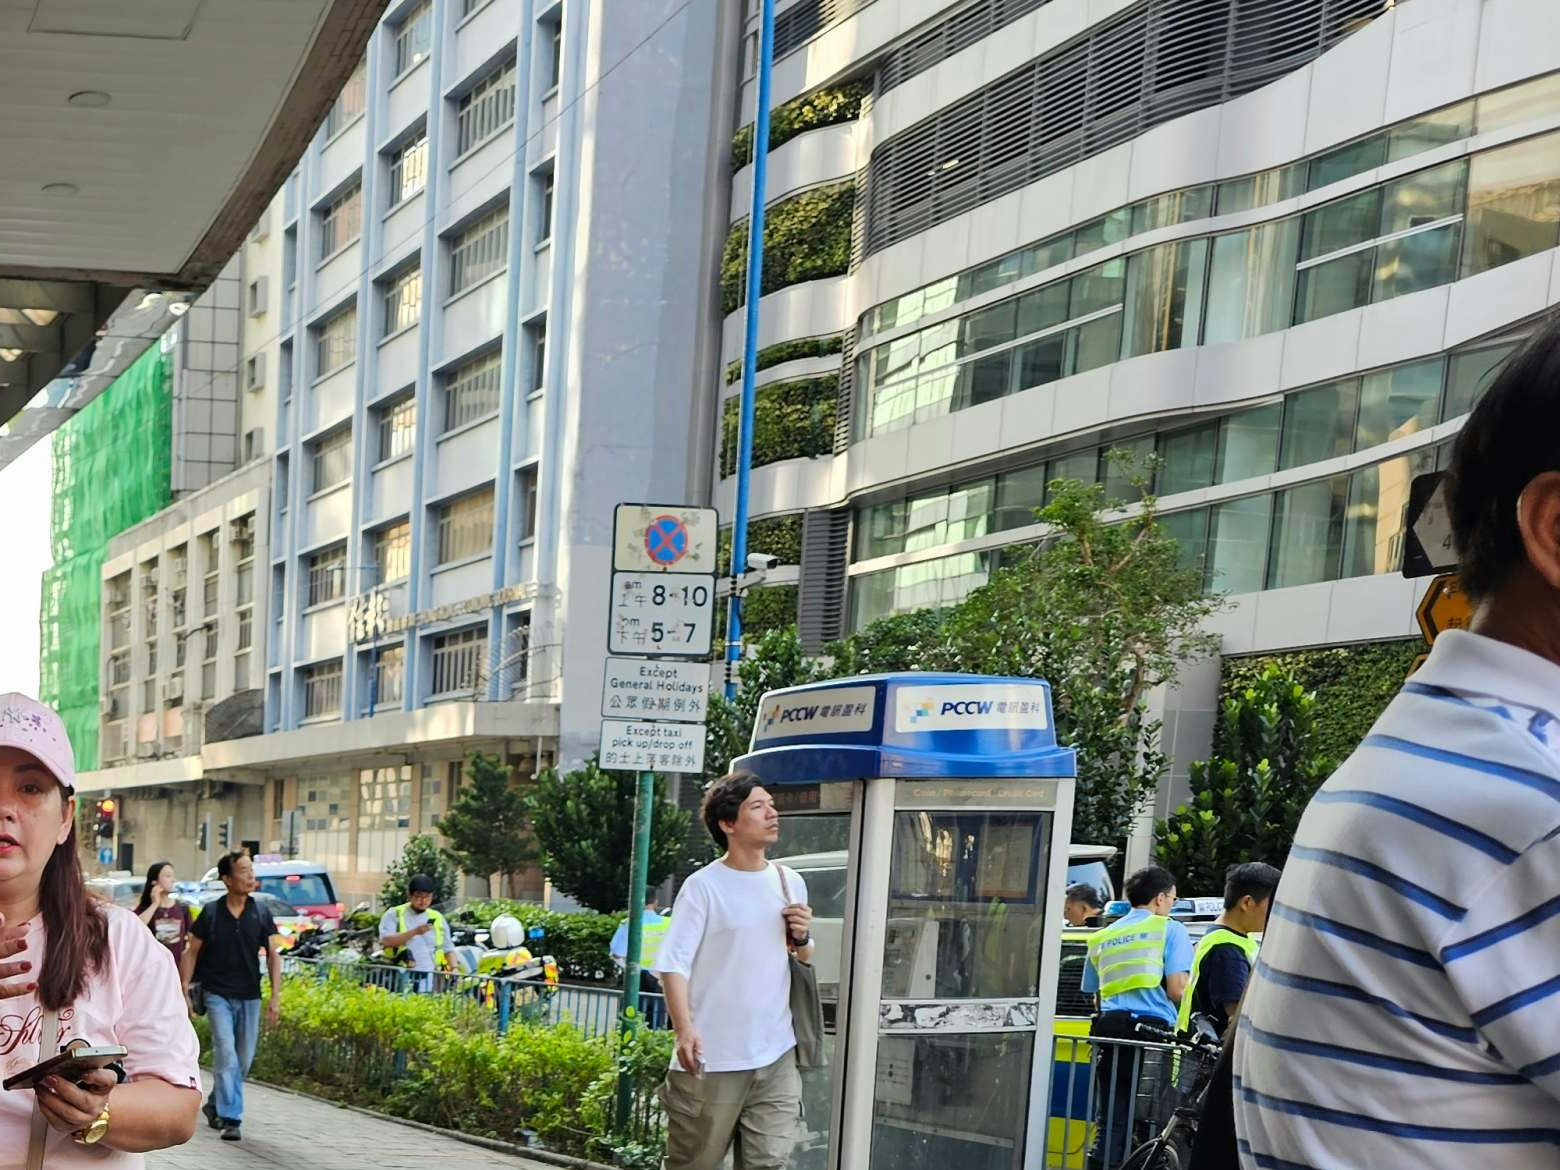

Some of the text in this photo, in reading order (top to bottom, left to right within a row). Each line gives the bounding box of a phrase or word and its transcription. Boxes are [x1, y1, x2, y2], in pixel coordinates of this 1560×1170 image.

[624, 581, 642, 590] am
[618, 593, 648, 608] 上午
[639, 666, 678, 679] Except
[610, 678, 704, 694] General Holidays
[780, 705, 819, 723] PCCW
[941, 701, 993, 716] PCCW
[626, 725, 682, 738] Except taxi
[612, 739, 693, 750] pick up/drop off
